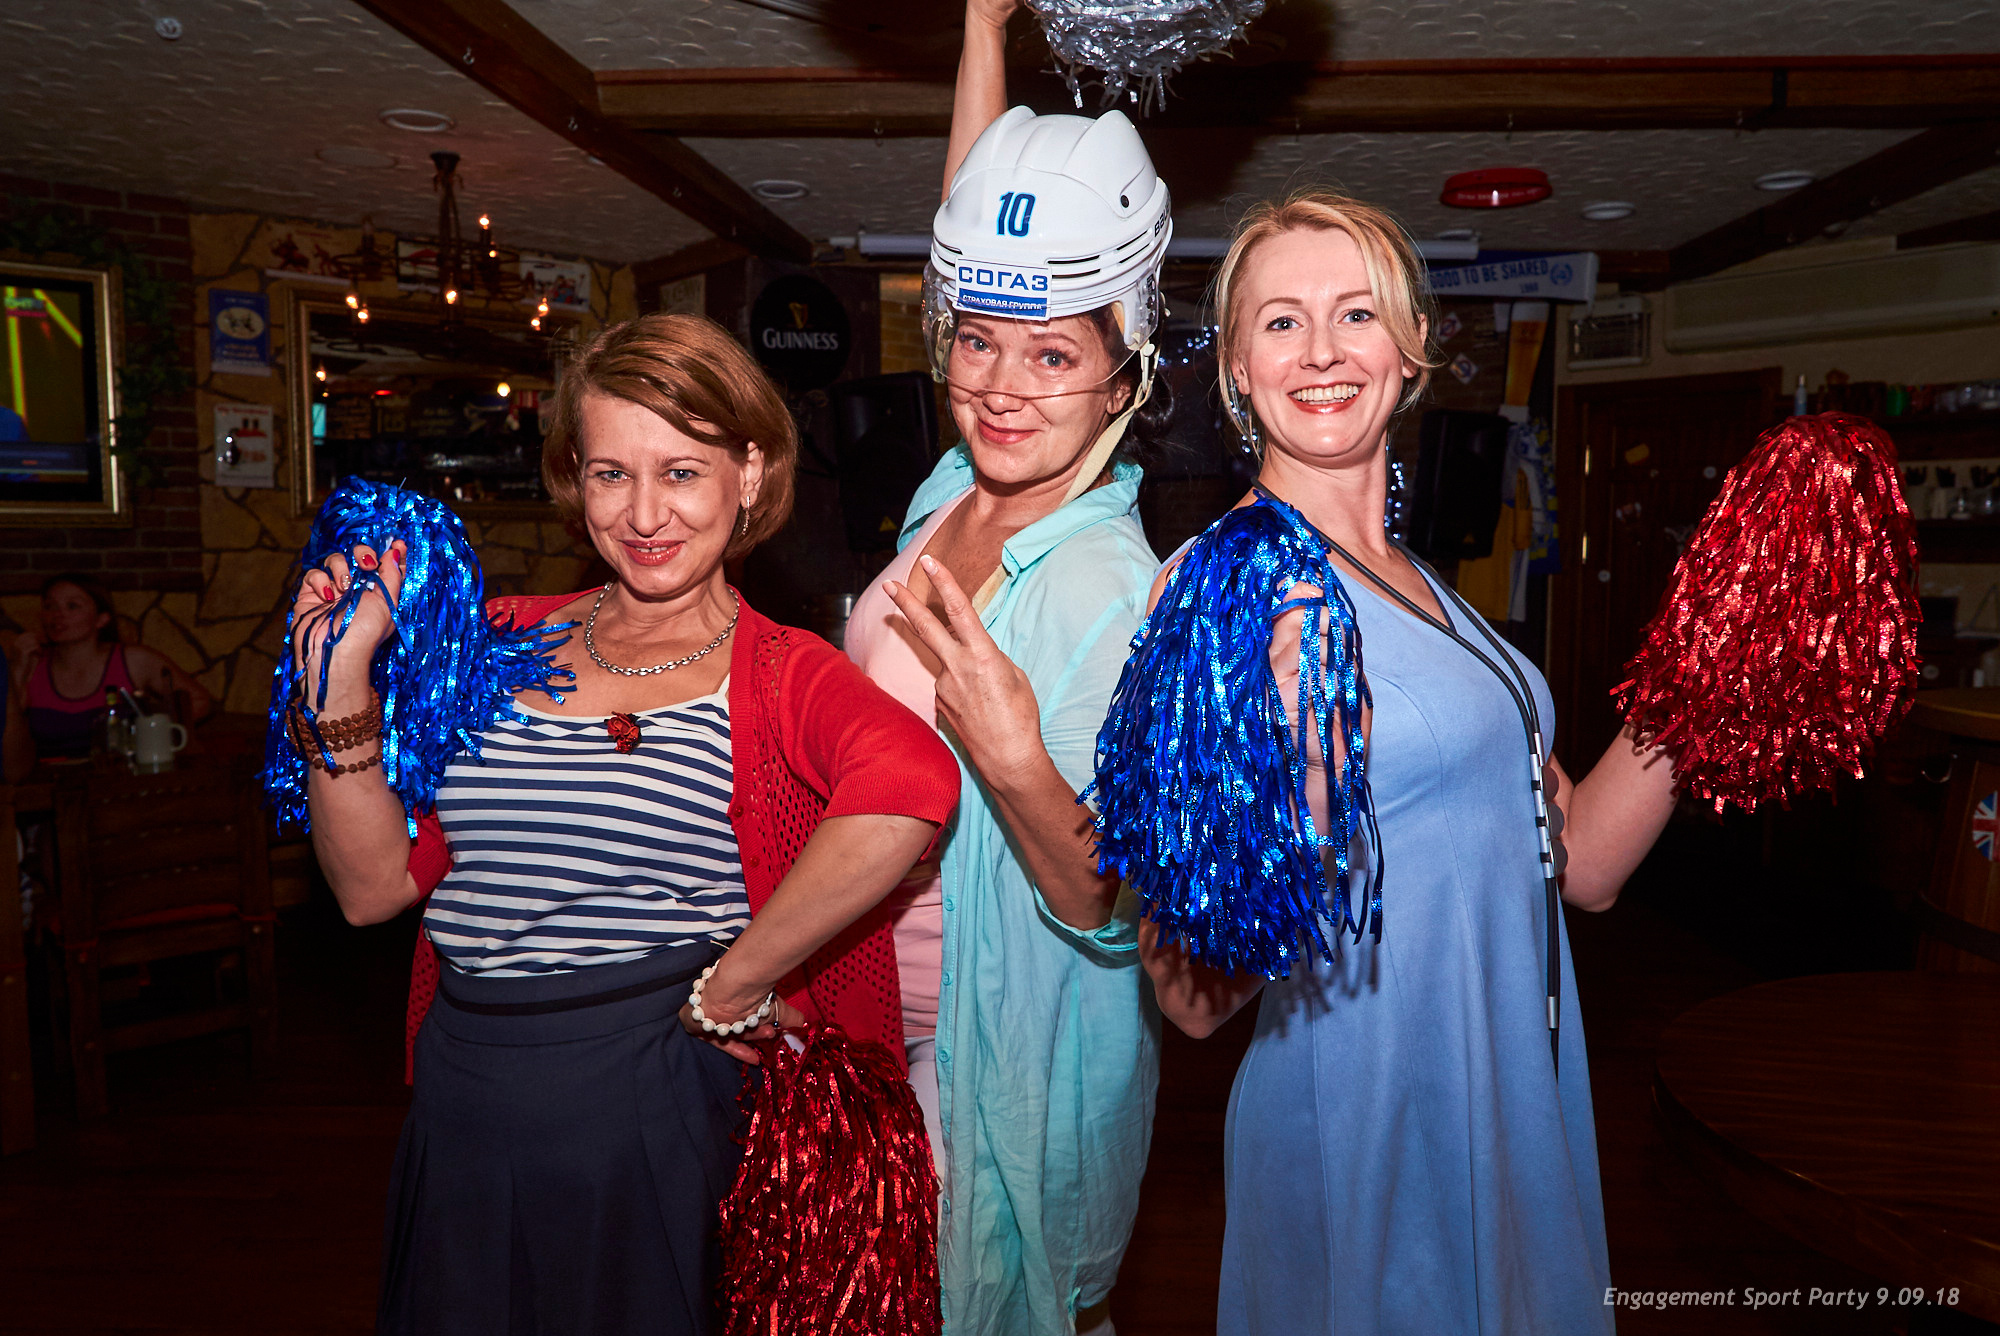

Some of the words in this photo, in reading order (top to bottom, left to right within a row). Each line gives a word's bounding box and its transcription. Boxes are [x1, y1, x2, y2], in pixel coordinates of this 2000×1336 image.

[997, 191, 1036, 237] 10
[958, 266, 1048, 292] СОГАЗ
[1463, 266, 1479, 284] TO
[1482, 264, 1498, 283] BE
[1501, 260, 1548, 280] SHARED
[962, 294, 1008, 307] СТРАХОВАЯ
[762, 327, 839, 351] GUINNESS
